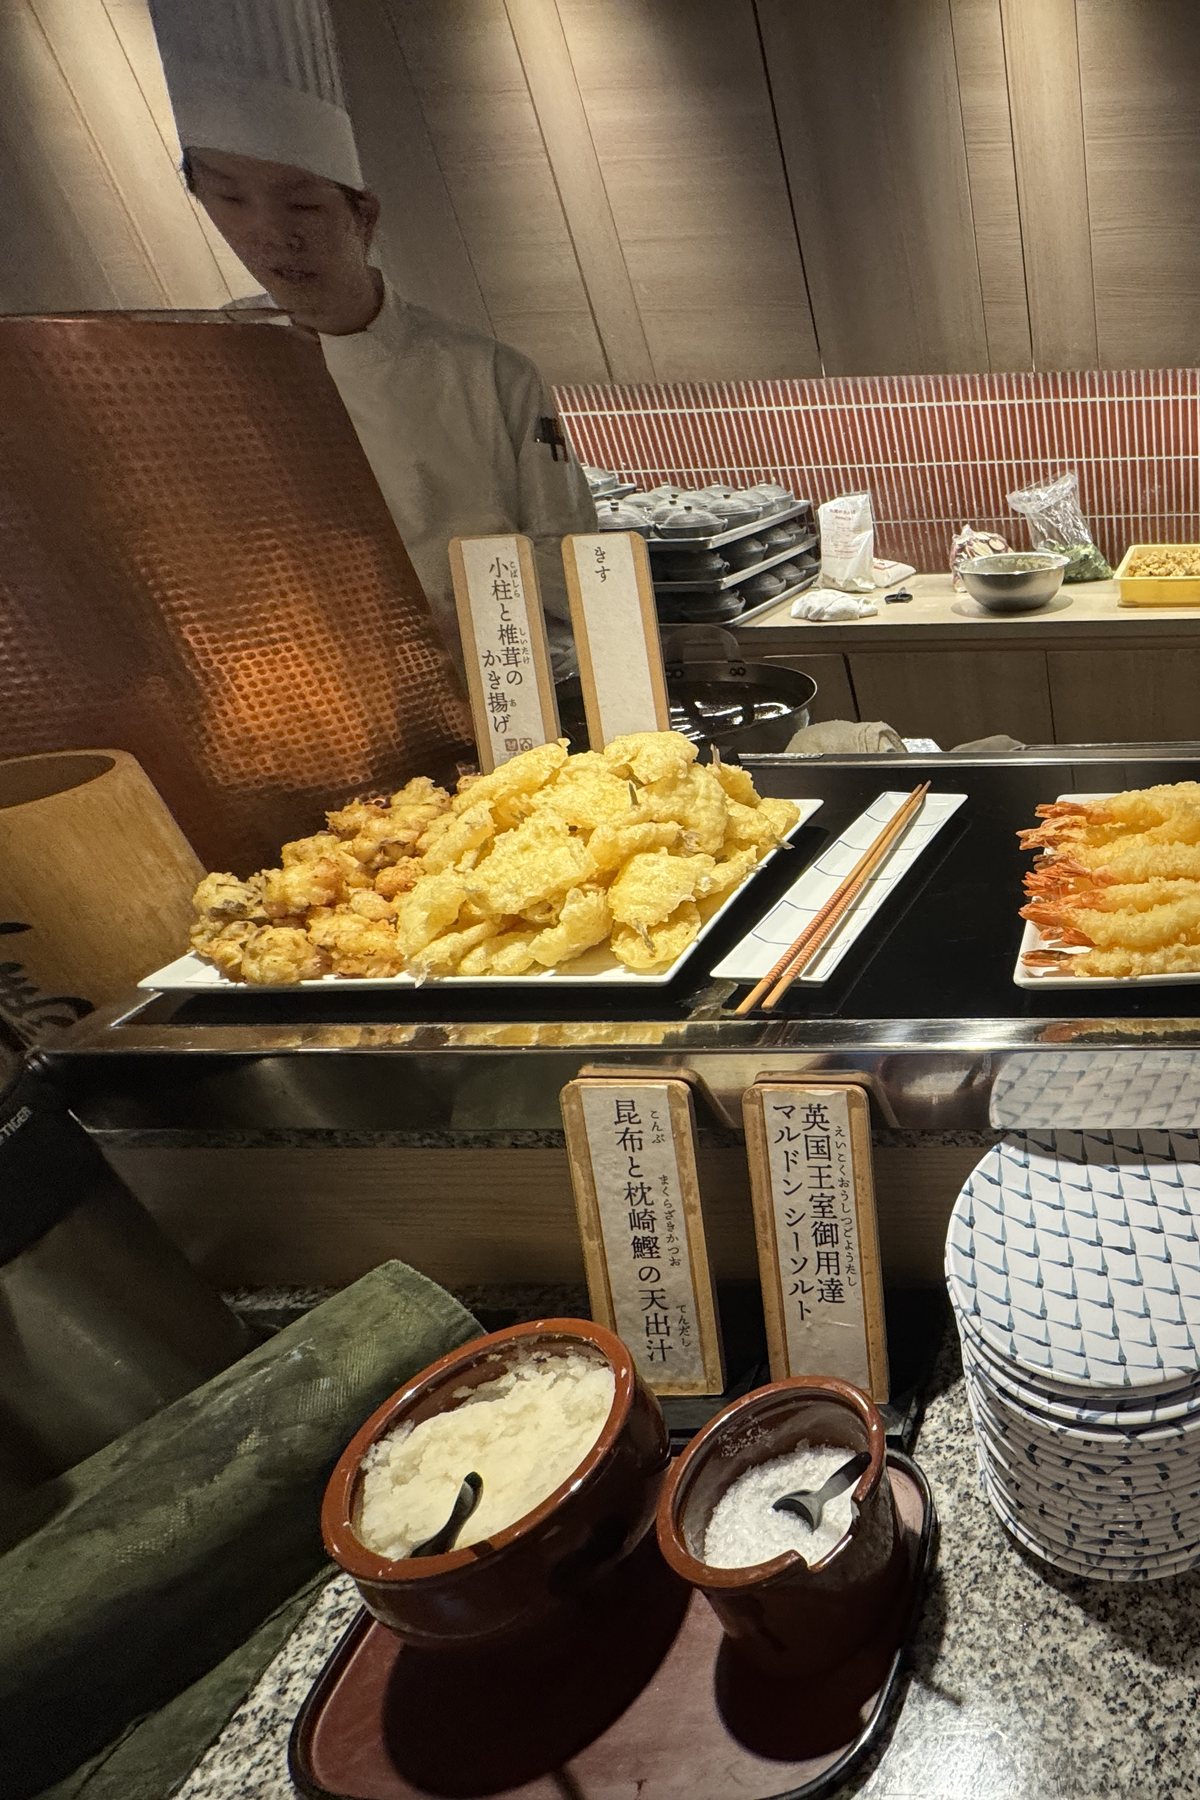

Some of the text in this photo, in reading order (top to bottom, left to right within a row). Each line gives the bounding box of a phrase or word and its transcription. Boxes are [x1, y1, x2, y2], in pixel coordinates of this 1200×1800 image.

[594, 546, 611, 582] きす
[489, 556, 523, 686] 小柱と椎茸の
[519, 627, 530, 664] しいたけ
[482, 650, 511, 734] かき揚げ
[650, 1110, 666, 1144] こんぶ
[613, 1099, 674, 1362] 昆布と枕崎鰹の天出汁
[800, 1103, 846, 1304] 英国王室御用達
